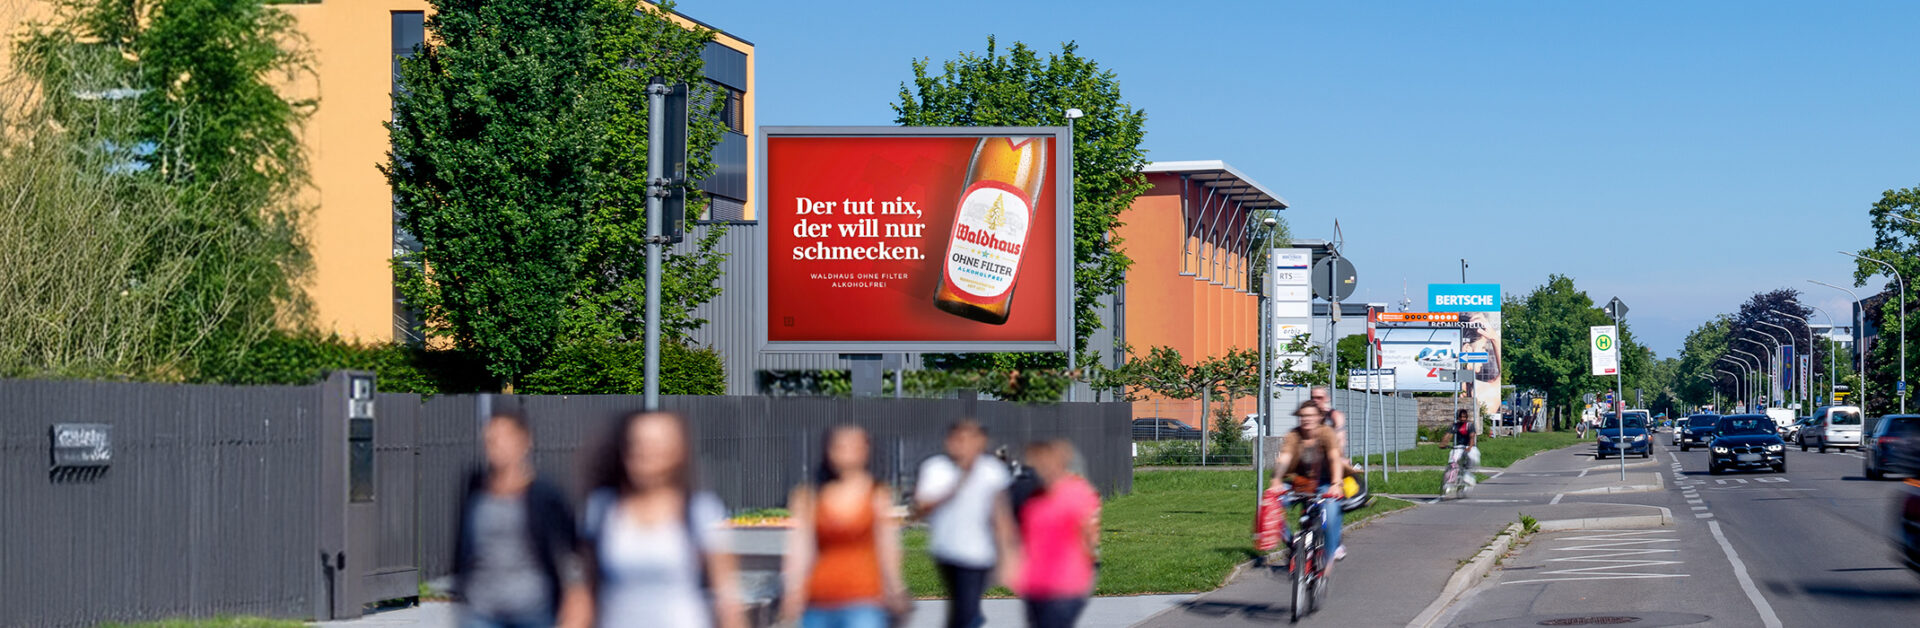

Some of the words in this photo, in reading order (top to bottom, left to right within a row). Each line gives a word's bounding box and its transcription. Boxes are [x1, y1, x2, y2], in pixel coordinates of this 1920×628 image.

[795, 197, 837, 215] Der
[842, 198, 875, 215] tut
[881, 196, 922, 219] nix,
[793, 219, 832, 238] der
[837, 219, 880, 238] will
[884, 223, 926, 238] nur
[956, 223, 1021, 255] Waldhaus
[792, 241, 925, 260] schmecken.
[952, 253, 980, 269] OHNE
[980, 260, 1013, 277] FILTER
[957, 266, 1003, 282] ALKOHOLFREI
[1279, 272, 1293, 280] RTS
[1435, 295, 1493, 306] BERTSCHE
